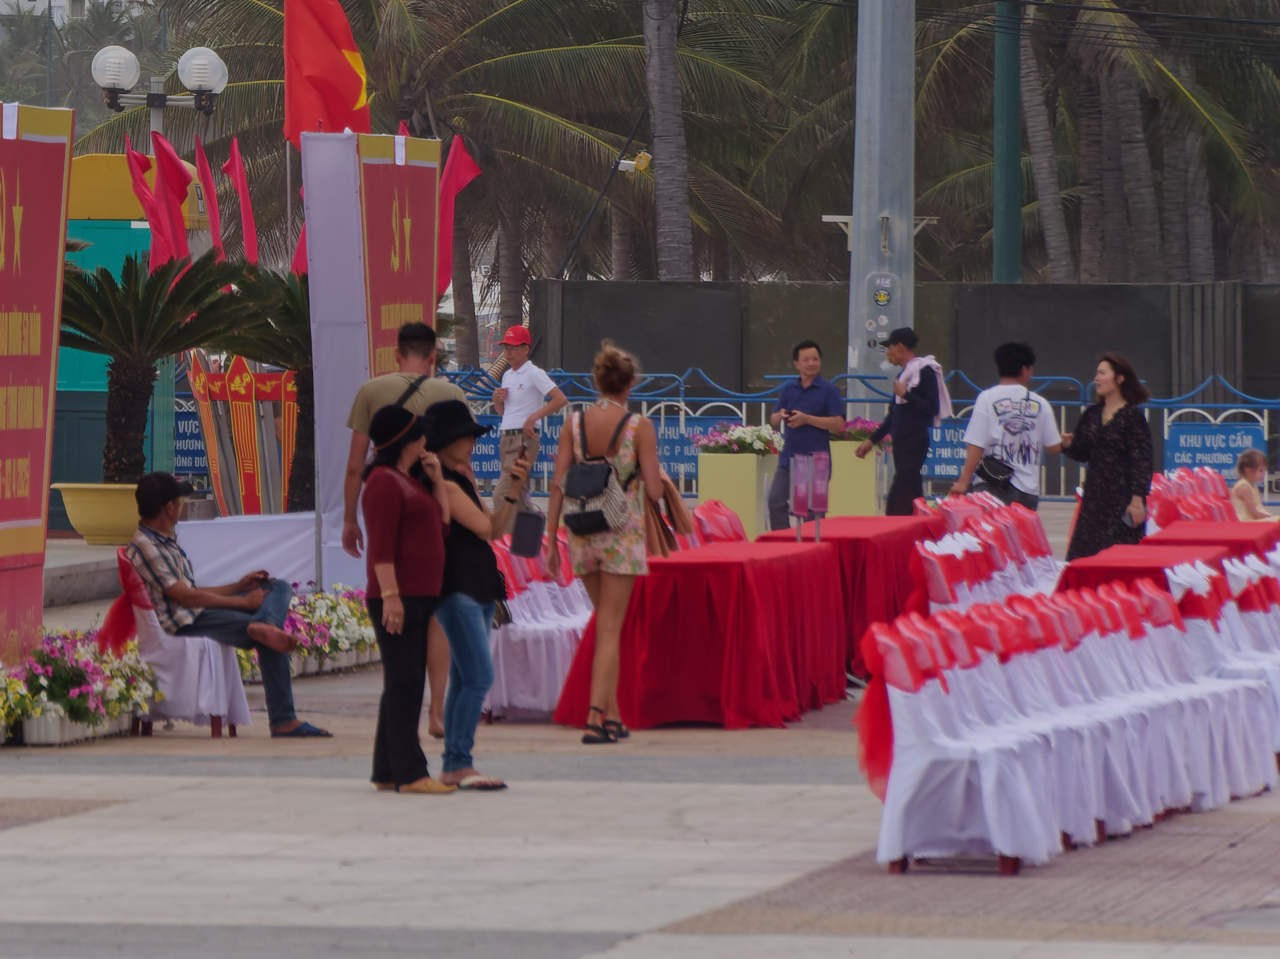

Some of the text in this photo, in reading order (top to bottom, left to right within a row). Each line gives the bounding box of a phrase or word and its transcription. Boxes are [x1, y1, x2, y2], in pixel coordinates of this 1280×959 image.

[178, 420, 199, 436] VỰC
[175, 439, 205, 450] HƯƠN
[1179, 431, 1253, 450] KHU VỰC CẤM
[1174, 451, 1193, 464] CÁC
[482, 458, 501, 472] ĐƯỜ
